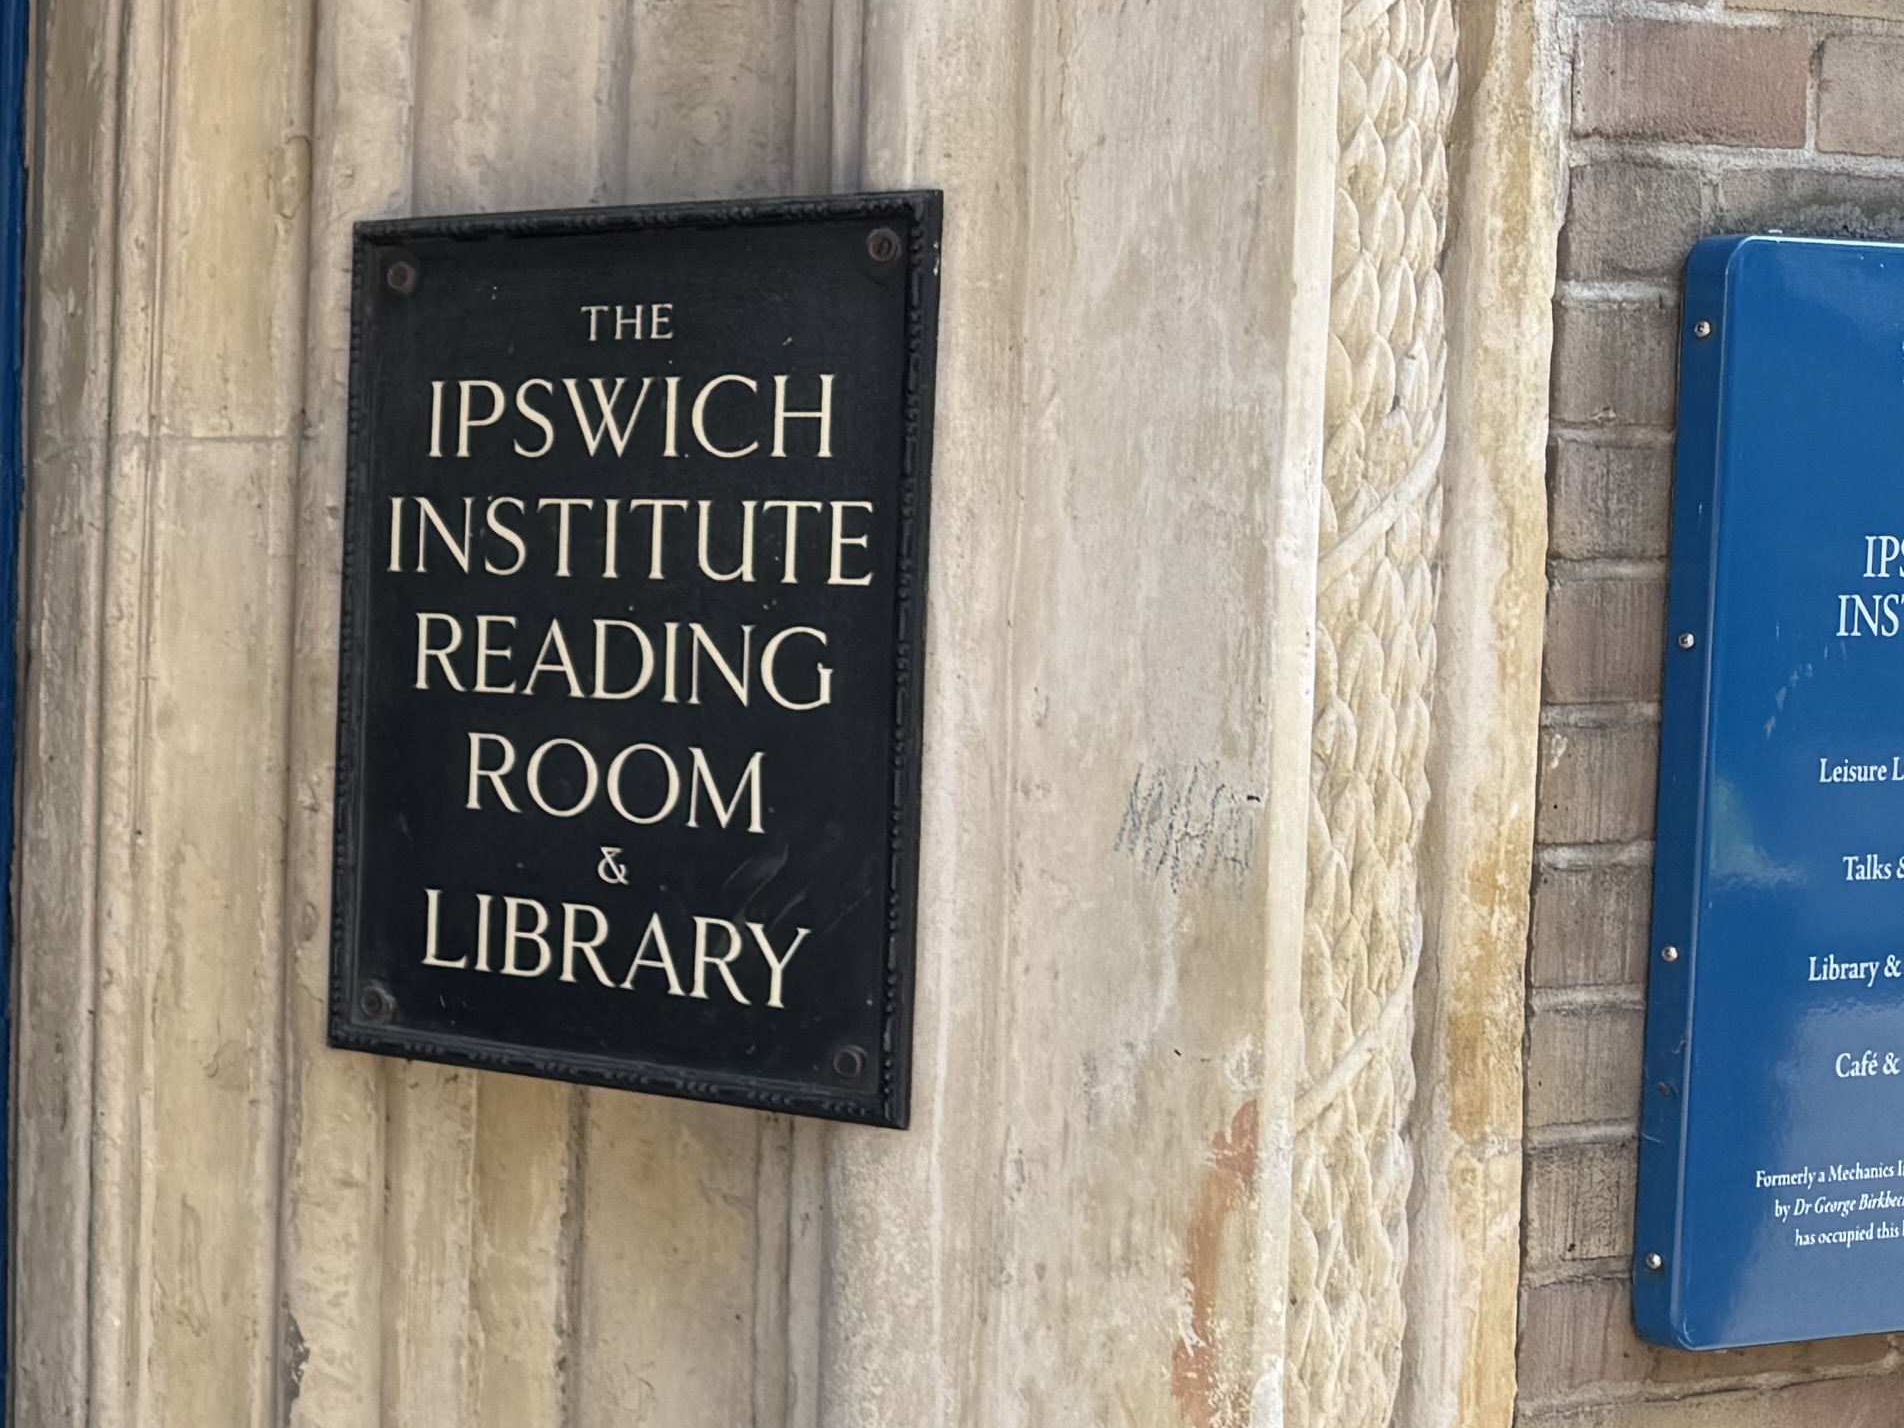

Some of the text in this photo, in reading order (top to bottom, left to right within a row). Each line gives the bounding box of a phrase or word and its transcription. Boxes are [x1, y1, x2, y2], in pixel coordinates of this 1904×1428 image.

[579, 303, 674, 342] THE
[427, 373, 836, 459] IPSWICH
[386, 495, 875, 587] INSTITUTE
[1835, 593, 1904, 638] INS
[414, 612, 835, 711] READING
[465, 731, 766, 835] ROOM
[1818, 757, 1888, 783] Leisure
[596, 846, 629, 886] &
[1843, 854, 1892, 881] Talks
[421, 888, 811, 1010] LIBRARY
[1808, 953, 1902, 988] Library &
[1835, 1050, 1901, 1078] Café &
[1756, 1166, 1816, 1189] Formerly
[1817, 1171, 1825, 1183] a
[1828, 1162, 1895, 1182] Mechanics
[1774, 1199, 1791, 1223] by
[1793, 1197, 1812, 1216] Dr
[1814, 1196, 1857, 1218] George
[1795, 1228, 1816, 1247] has
[1817, 1222, 1874, 1248] occupied
[1876, 1221, 1899, 1239] this
